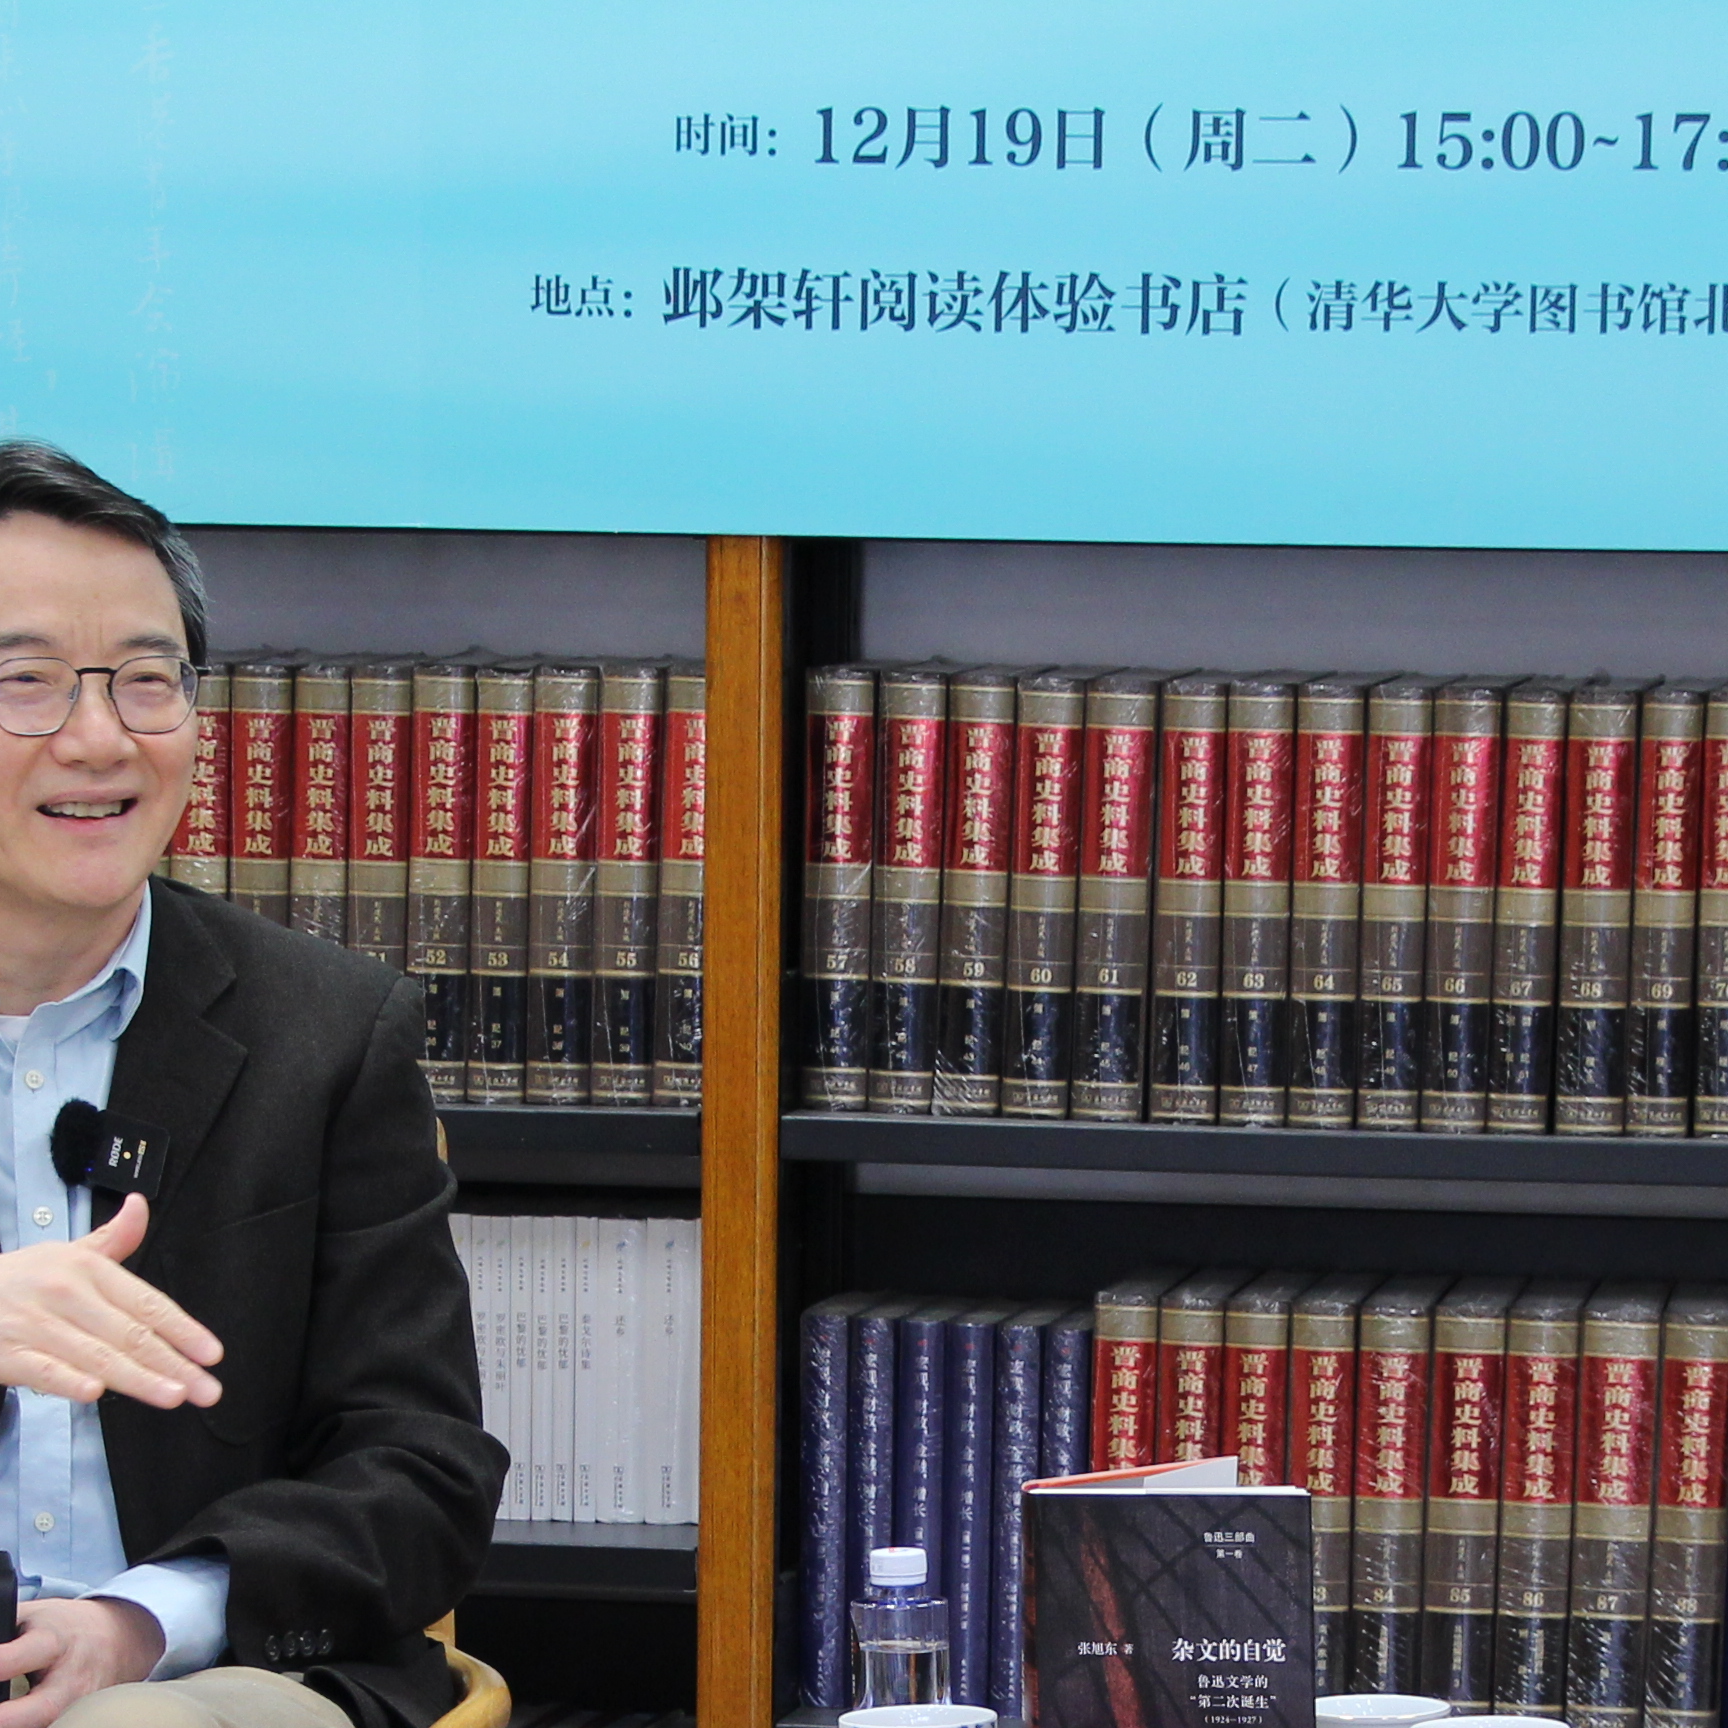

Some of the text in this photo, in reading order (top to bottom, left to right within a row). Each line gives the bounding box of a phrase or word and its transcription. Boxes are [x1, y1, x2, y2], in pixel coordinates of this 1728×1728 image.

[242, 717, 274, 856] 晋商史料集成
[302, 718, 335, 857] 晋商史料集成
[363, 717, 396, 858] 晋商史料集成
[423, 716, 458, 857] 晋商史料集成
[485, 718, 518, 858] 晋商史料集成
[546, 717, 580, 858] 晋商史料集成
[612, 717, 645, 858] 晋商史料集成
[822, 720, 854, 862] 晋商史料集成
[892, 722, 925, 865] 晋商史料集成
[960, 724, 993, 868] 晋商史料集成
[1028, 731, 1067, 875] 晋商史料集成
[1097, 732, 1133, 876] 晋商史料集成
[1175, 736, 1210, 879] 晋商史料集成
[1240, 735, 1276, 879] 晋商史料集成
[1311, 737, 1347, 881] 晋商史料集成
[1379, 738, 1416, 882] 晋商史料集成
[1446, 740, 1477, 882] 晋商史料集成
[1510, 743, 1545, 886] 晋商史料集成
[1578, 743, 1617, 888] 晋商史料集成
[1651, 742, 1686, 887] 晋商史料集成
[426, 950, 448, 966] 52
[487, 951, 509, 968] 53
[548, 951, 570, 968] 54
[615, 951, 638, 968] 55
[678, 951, 700, 968] 56
[826, 953, 849, 971] 57
[894, 957, 917, 975] 58
[962, 961, 986, 978] 59
[1030, 967, 1053, 984] 60
[1098, 967, 1120, 985] 61
[1176, 971, 1198, 988] 62
[1243, 972, 1265, 989] 63
[1313, 973, 1335, 991] 64
[1381, 976, 1404, 994] 65
[1444, 977, 1466, 996] 66
[1509, 979, 1533, 998] 67
[1579, 979, 1603, 999] 68
[1650, 982, 1674, 1000] 69
[1106, 1345, 1140, 1470] 晋商史料集
[1305, 1354, 1338, 1495] 晋商史料集成
[1374, 1354, 1410, 1495] 晋商史料集成
[1448, 1357, 1483, 1496] 晋商史料集成
[1523, 1360, 1559, 1499] 晋商史料集成
[1597, 1362, 1635, 1502] 晋商史料集成
[1676, 1364, 1715, 1505] 晋商史料集成
[1203, 1531, 1256, 1544] 鲁迅三部曲
[1373, 1588, 1395, 1603] 84
[1449, 1588, 1472, 1604] 85
[1522, 1591, 1545, 1607] 86
[1596, 1595, 1619, 1612] 87
[1077, 1641, 1134, 1657] 张旭东 著
[1171, 1637, 1287, 1663] 杂文的自觉
[1197, 1674, 1269, 1690] 鲁迅文学的
[1189, 1693, 1277, 1710] “第二次诞生”
